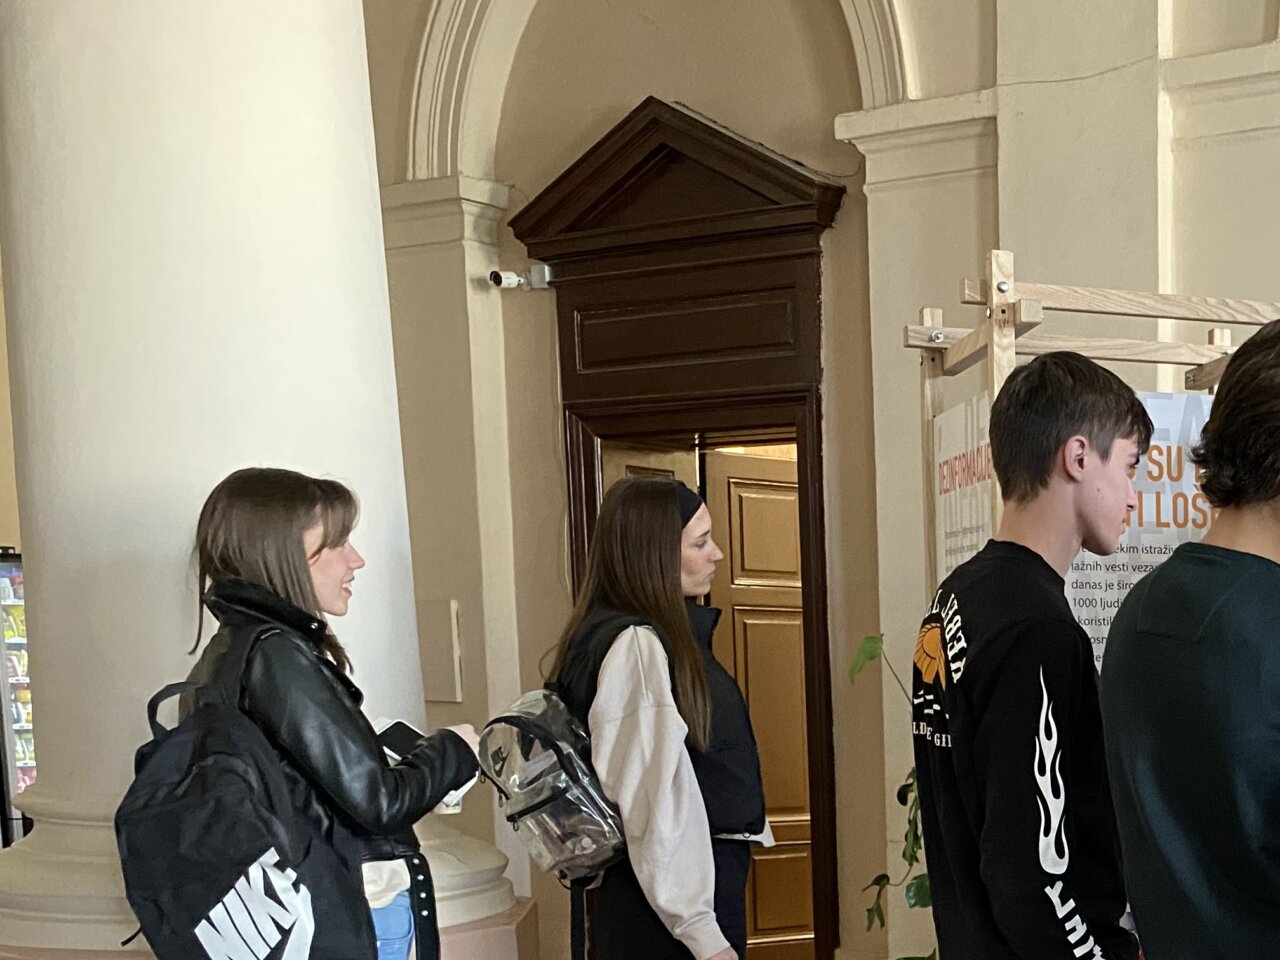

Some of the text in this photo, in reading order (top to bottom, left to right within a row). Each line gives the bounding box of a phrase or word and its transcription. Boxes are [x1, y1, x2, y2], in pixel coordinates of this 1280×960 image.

[1146, 445, 1184, 482] SU
[1155, 483, 1220, 529] LOŠ
[1106, 562, 1129, 573] vesti
[1071, 579, 1135, 592] danas je širo
[1072, 597, 1098, 608] 1000
